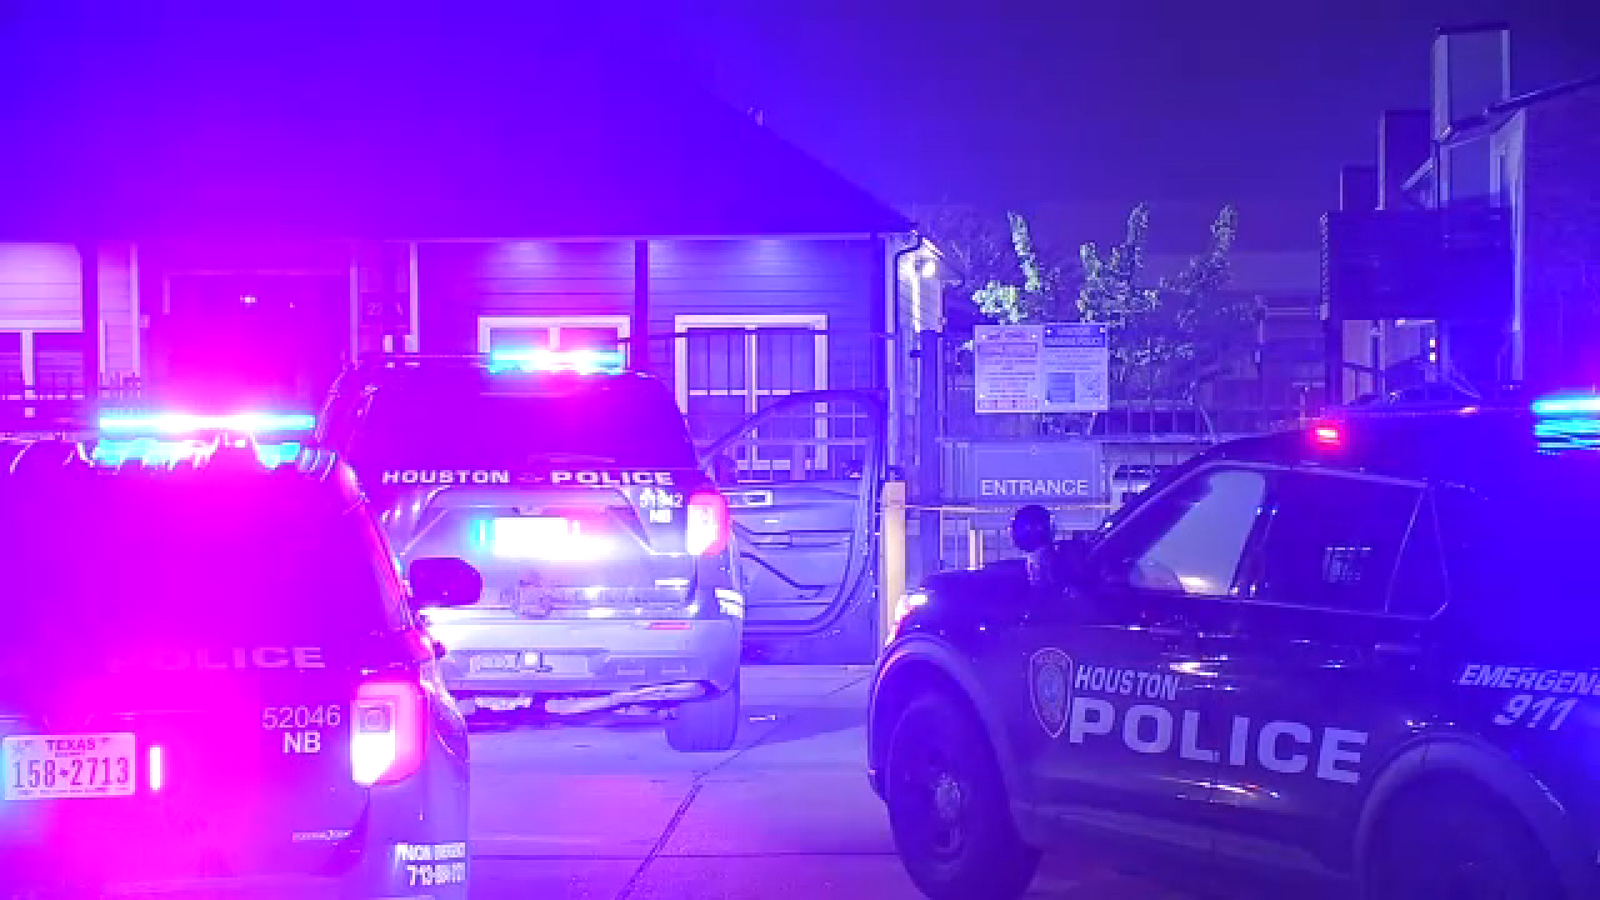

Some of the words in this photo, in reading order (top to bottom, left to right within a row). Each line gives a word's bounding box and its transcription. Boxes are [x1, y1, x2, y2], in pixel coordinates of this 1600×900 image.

[382, 469, 510, 484] HOUSTON
[551, 470, 675, 486] POLICE
[981, 479, 1089, 496] ENTRANCE
[106, 645, 326, 673] POLICE
[1075, 664, 1180, 700] HOUSTON
[262, 704, 341, 729] 52046
[1493, 694, 1578, 730] 911
[45, 737, 97, 750] TEXAS
[283, 731, 321, 753] NB
[1069, 697, 1369, 785] POLICE
